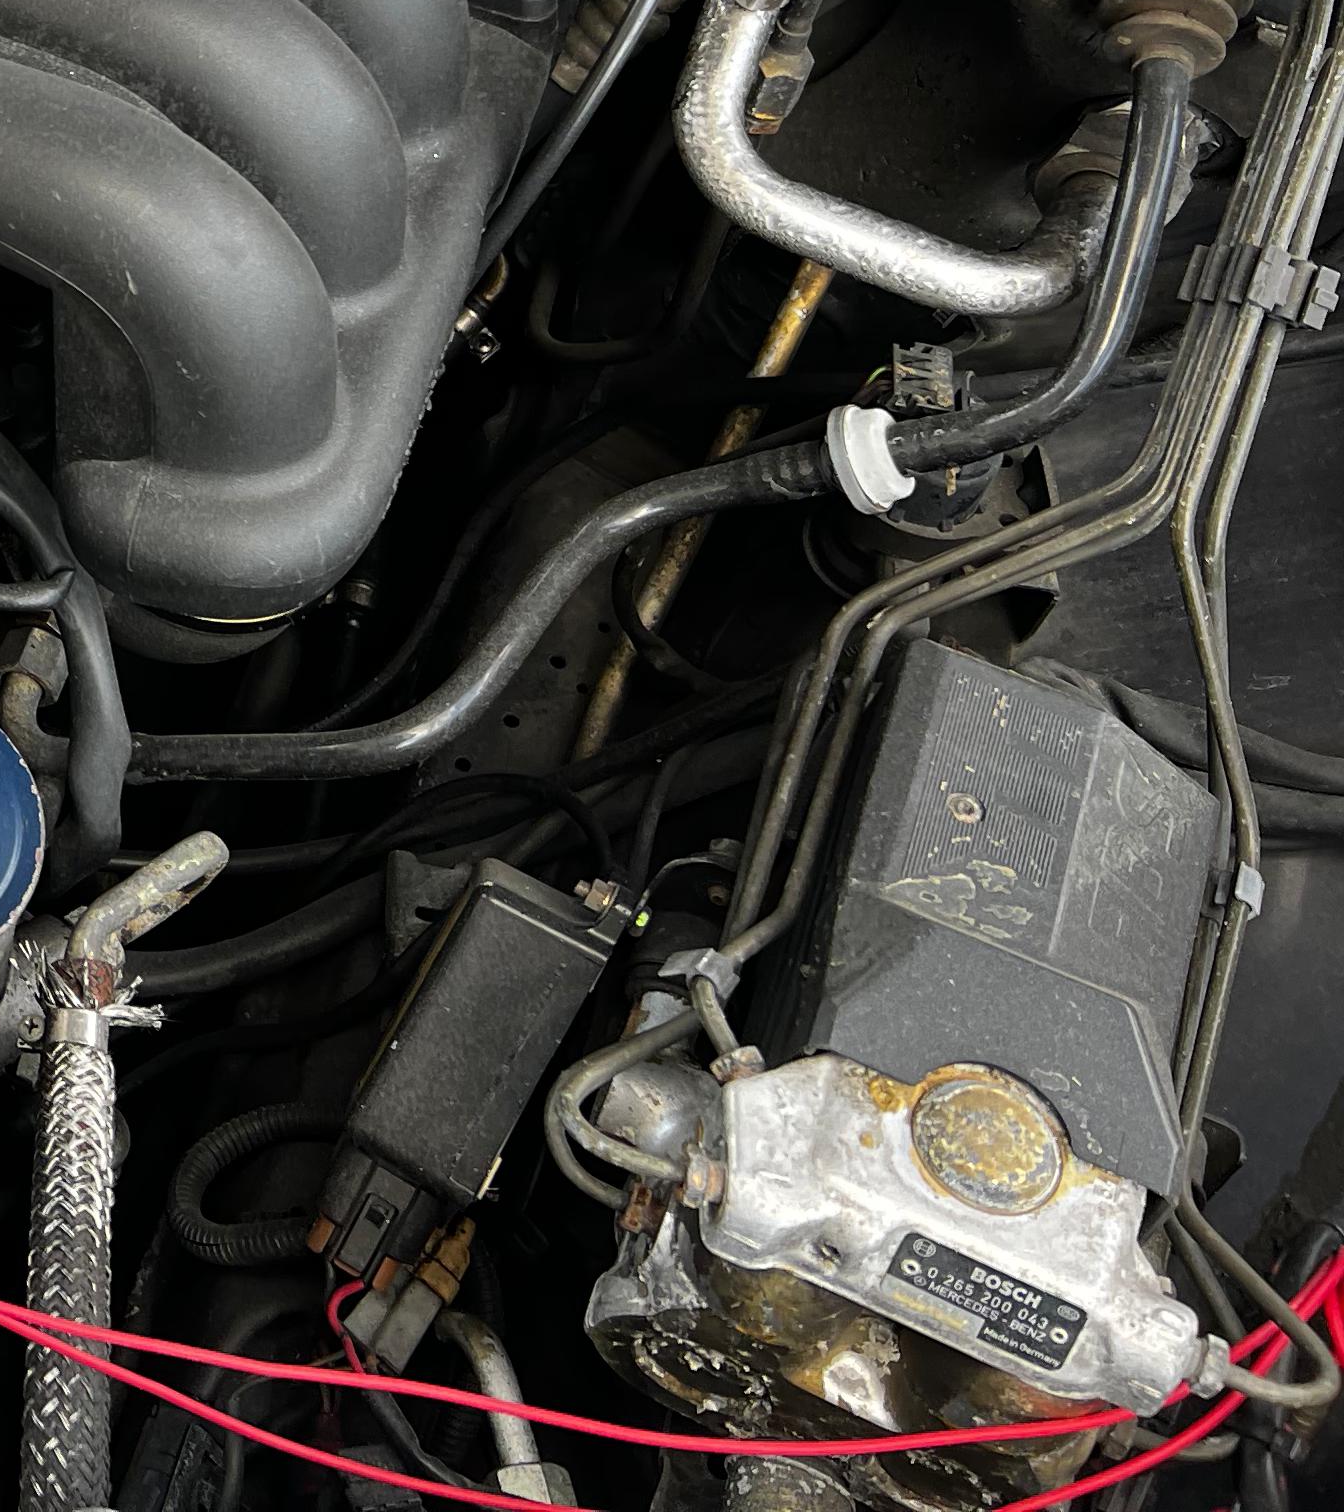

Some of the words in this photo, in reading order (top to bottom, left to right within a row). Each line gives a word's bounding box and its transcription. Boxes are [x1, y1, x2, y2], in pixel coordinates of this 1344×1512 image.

[927, 1266, 939, 1280] 0
[945, 1273, 975, 1297] 265
[980, 1290, 1013, 1314] 200
[1018, 1307, 1049, 1330] 043
[927, 1281, 1000, 1322] MERCEDES
[1009, 1320, 1048, 1343] BENZ
[970, 1267, 1042, 1307] BOSCH
[983, 1326, 1010, 1346] Made
[1020, 1341, 1061, 1368] Germany
